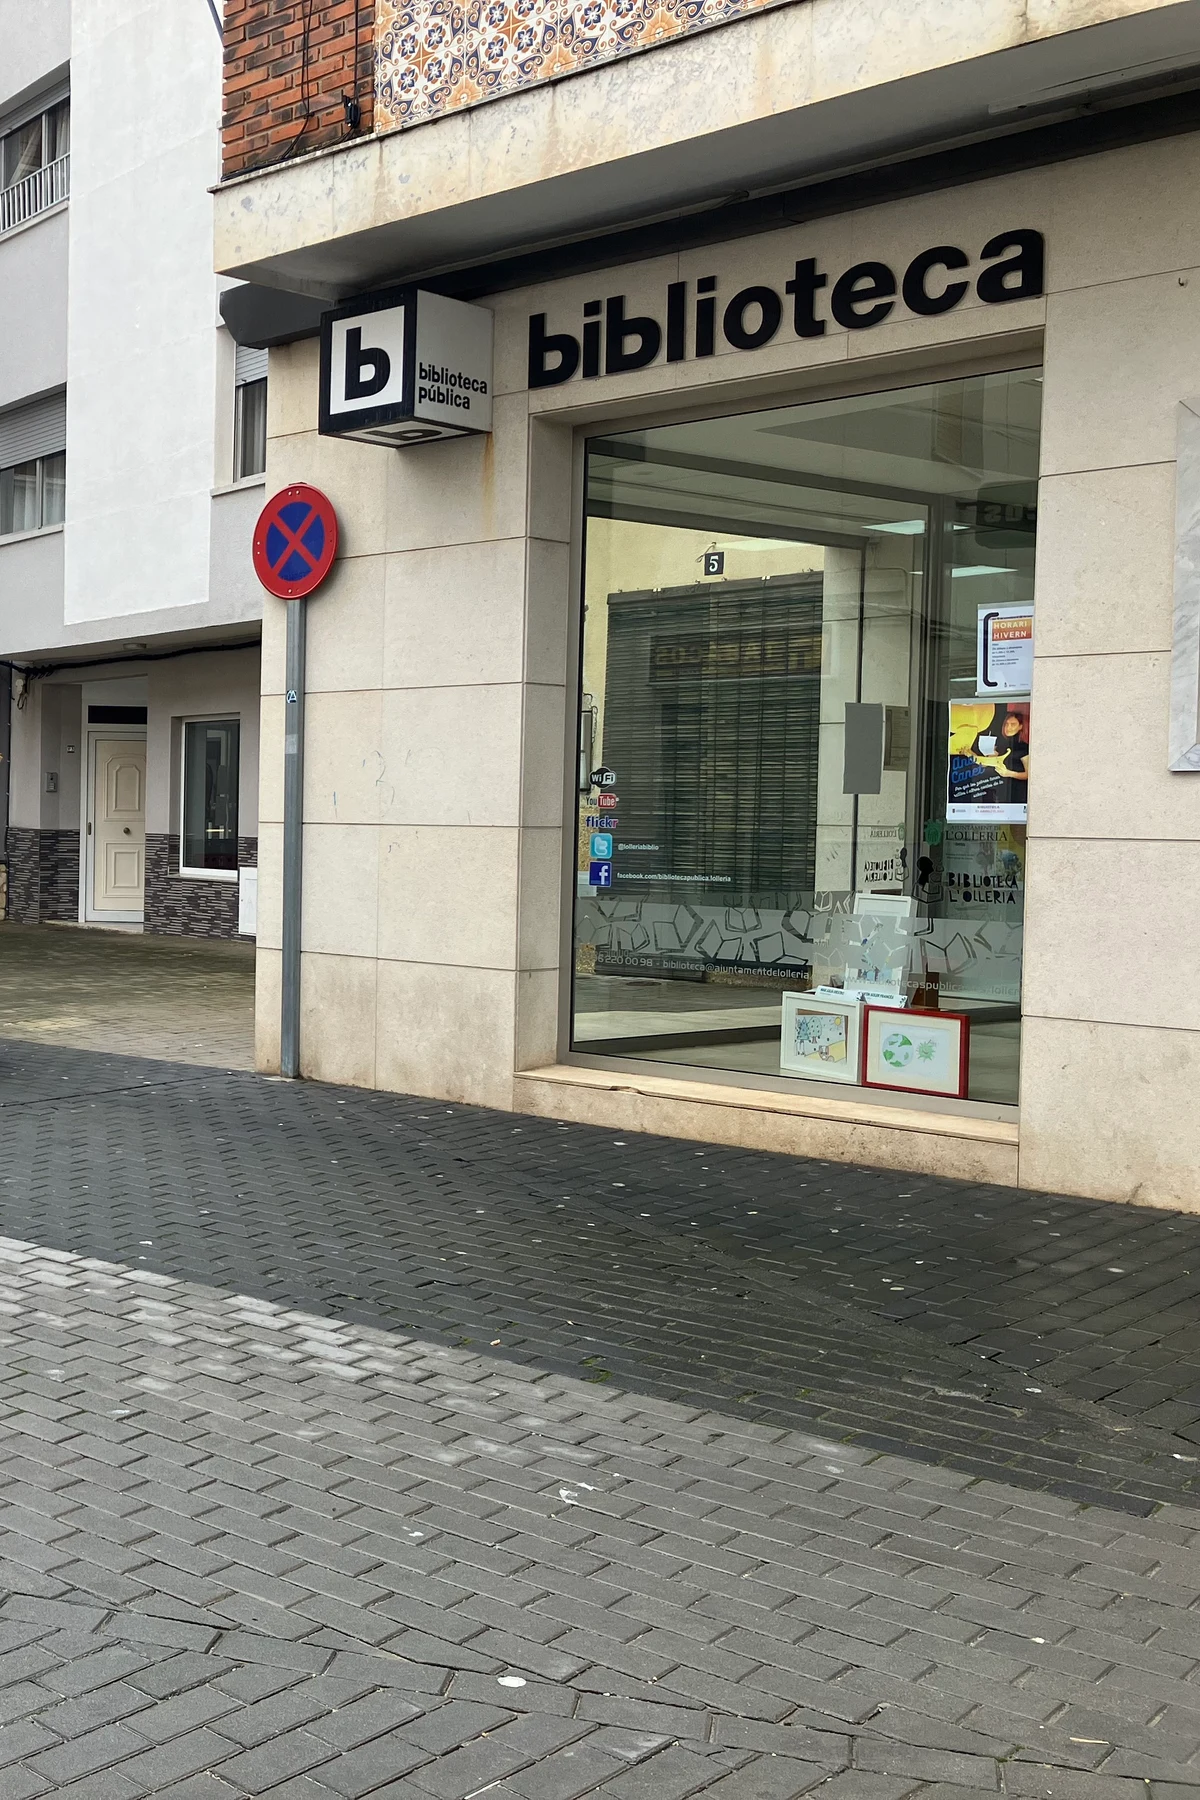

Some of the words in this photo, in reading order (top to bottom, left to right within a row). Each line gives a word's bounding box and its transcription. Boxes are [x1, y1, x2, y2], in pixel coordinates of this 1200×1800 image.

[528, 228, 1045, 390] biblioteca
[344, 326, 391, 401] b
[418, 362, 488, 395] biblioteca
[418, 384, 471, 410] pública
[709, 555, 719, 572] 5
[993, 621, 1027, 630] HORARI
[993, 631, 1027, 640] HIVERN
[952, 764, 986, 784] Canet
[586, 797, 615, 807] YouTube
[586, 816, 618, 828] flickr
[945, 830, 1008, 842] L'OLLERIA
[947, 872, 1018, 889] BIBLIOTECA
[949, 890, 1016, 904] L'OLLERIA
